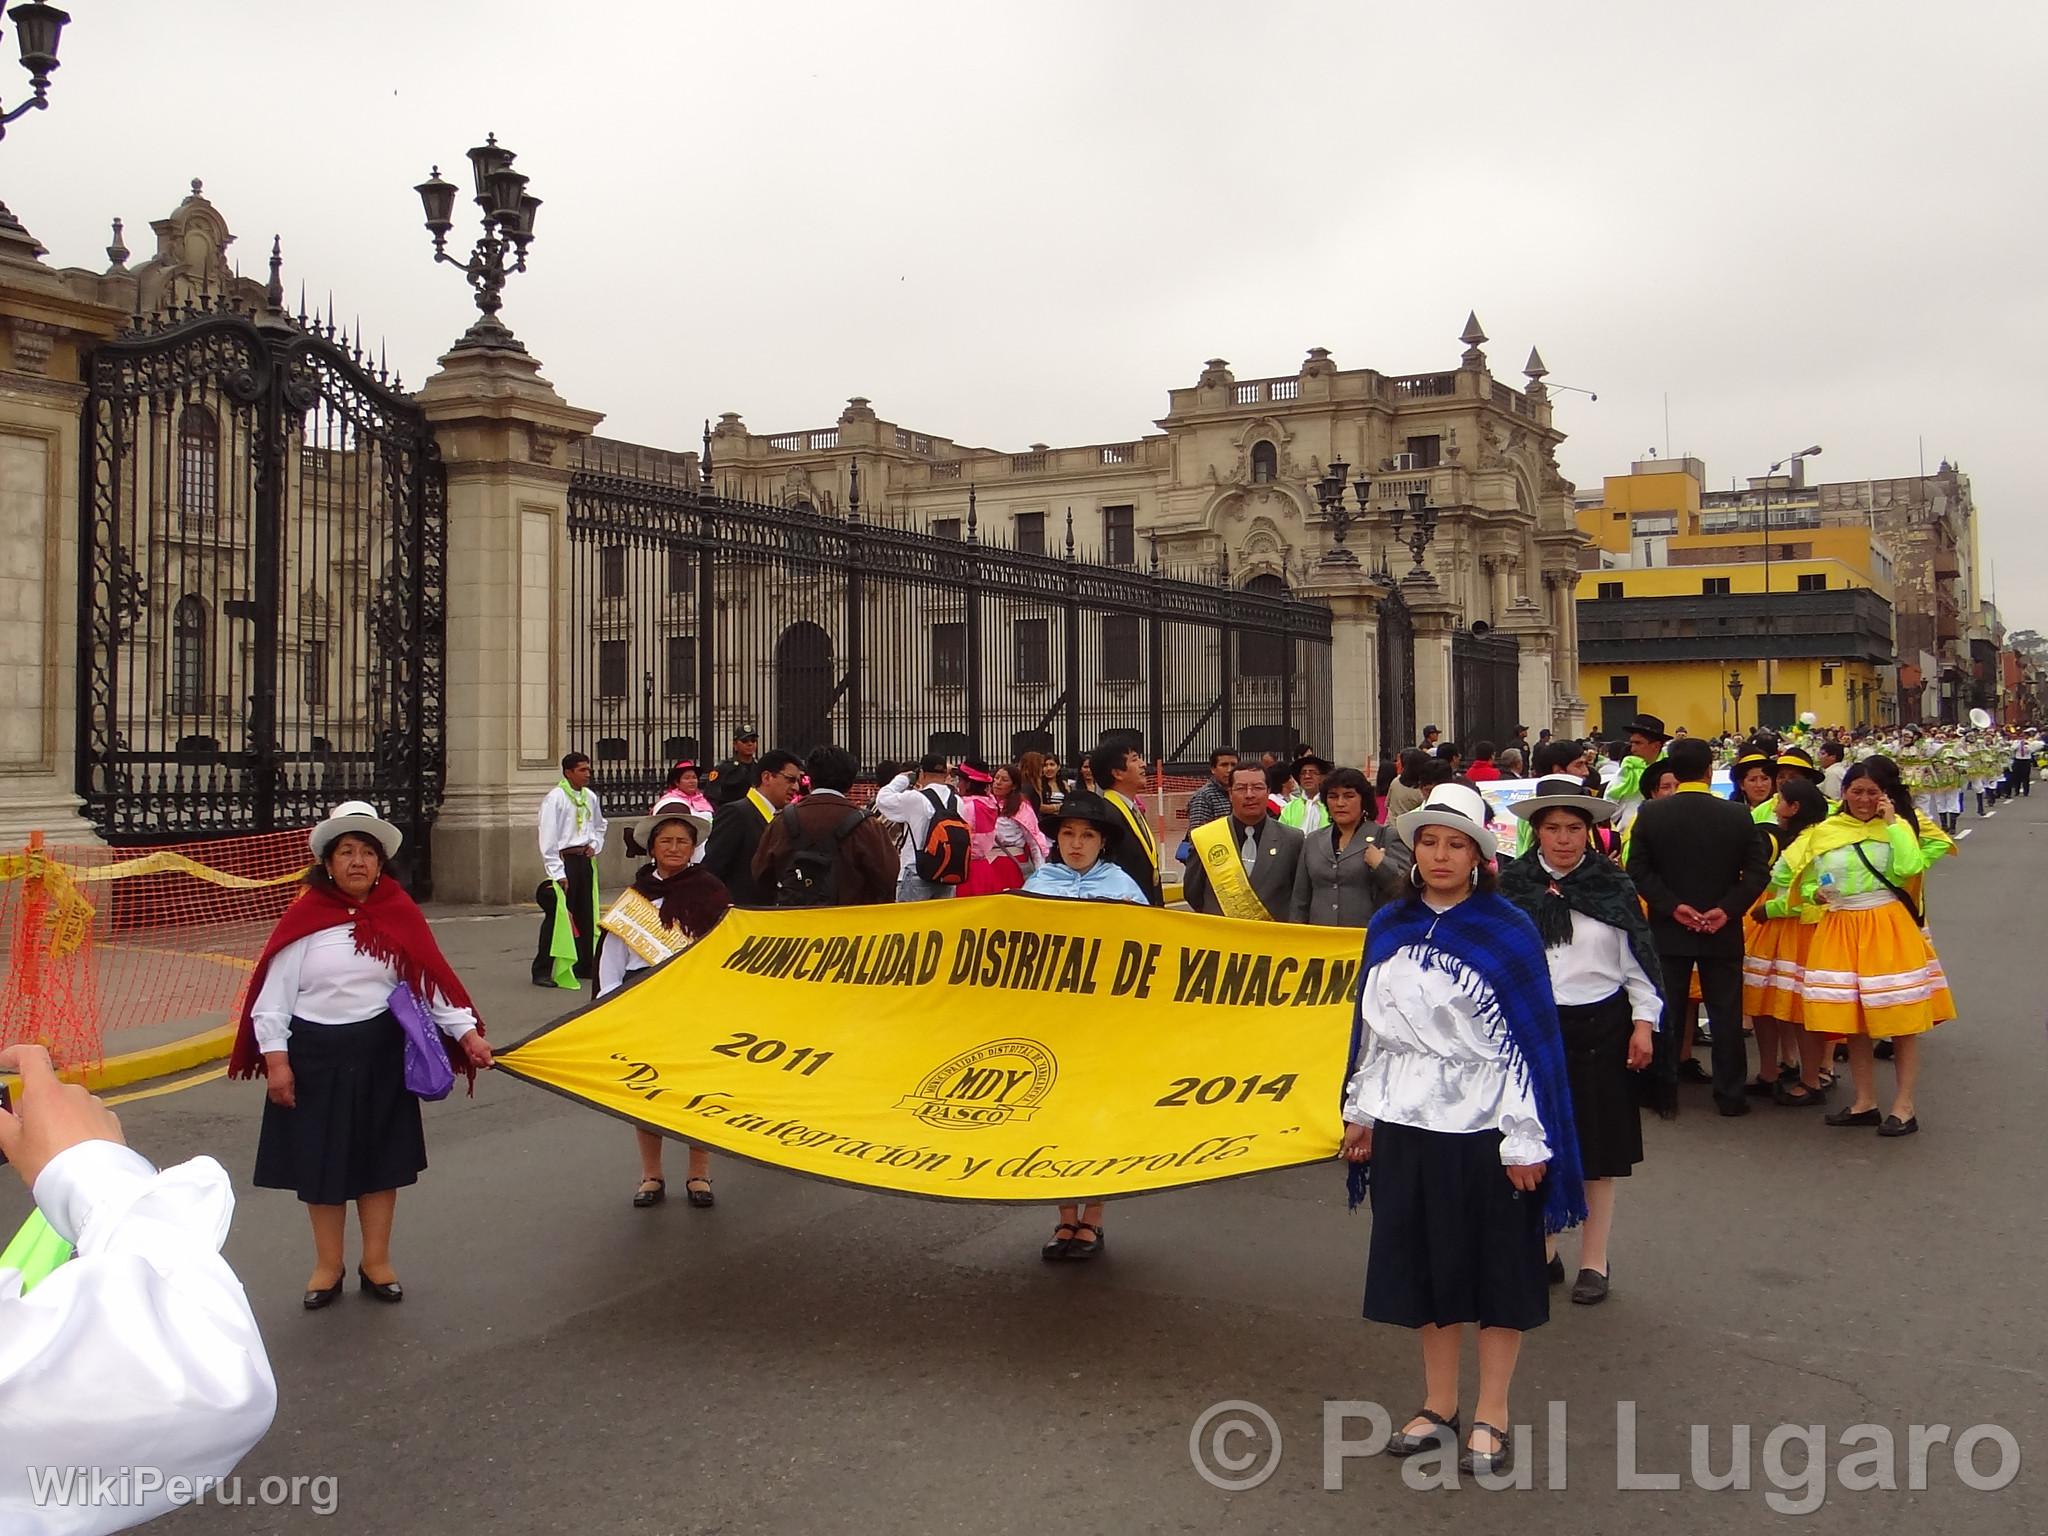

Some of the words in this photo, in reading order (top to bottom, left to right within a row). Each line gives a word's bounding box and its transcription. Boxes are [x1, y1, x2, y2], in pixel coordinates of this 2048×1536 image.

[721, 930, 944, 987] MUNICIPALIDAD
[948, 928, 1102, 995] DISTRITAL
[1111, 940, 1163, 999] DE
[711, 1032, 834, 1077] 2011
[945, 1066, 1033, 1103] MDY
[1153, 1073, 1300, 1108] 2014
[921, 1104, 1006, 1123] PASCO
[946, 1156, 993, 1181] y
